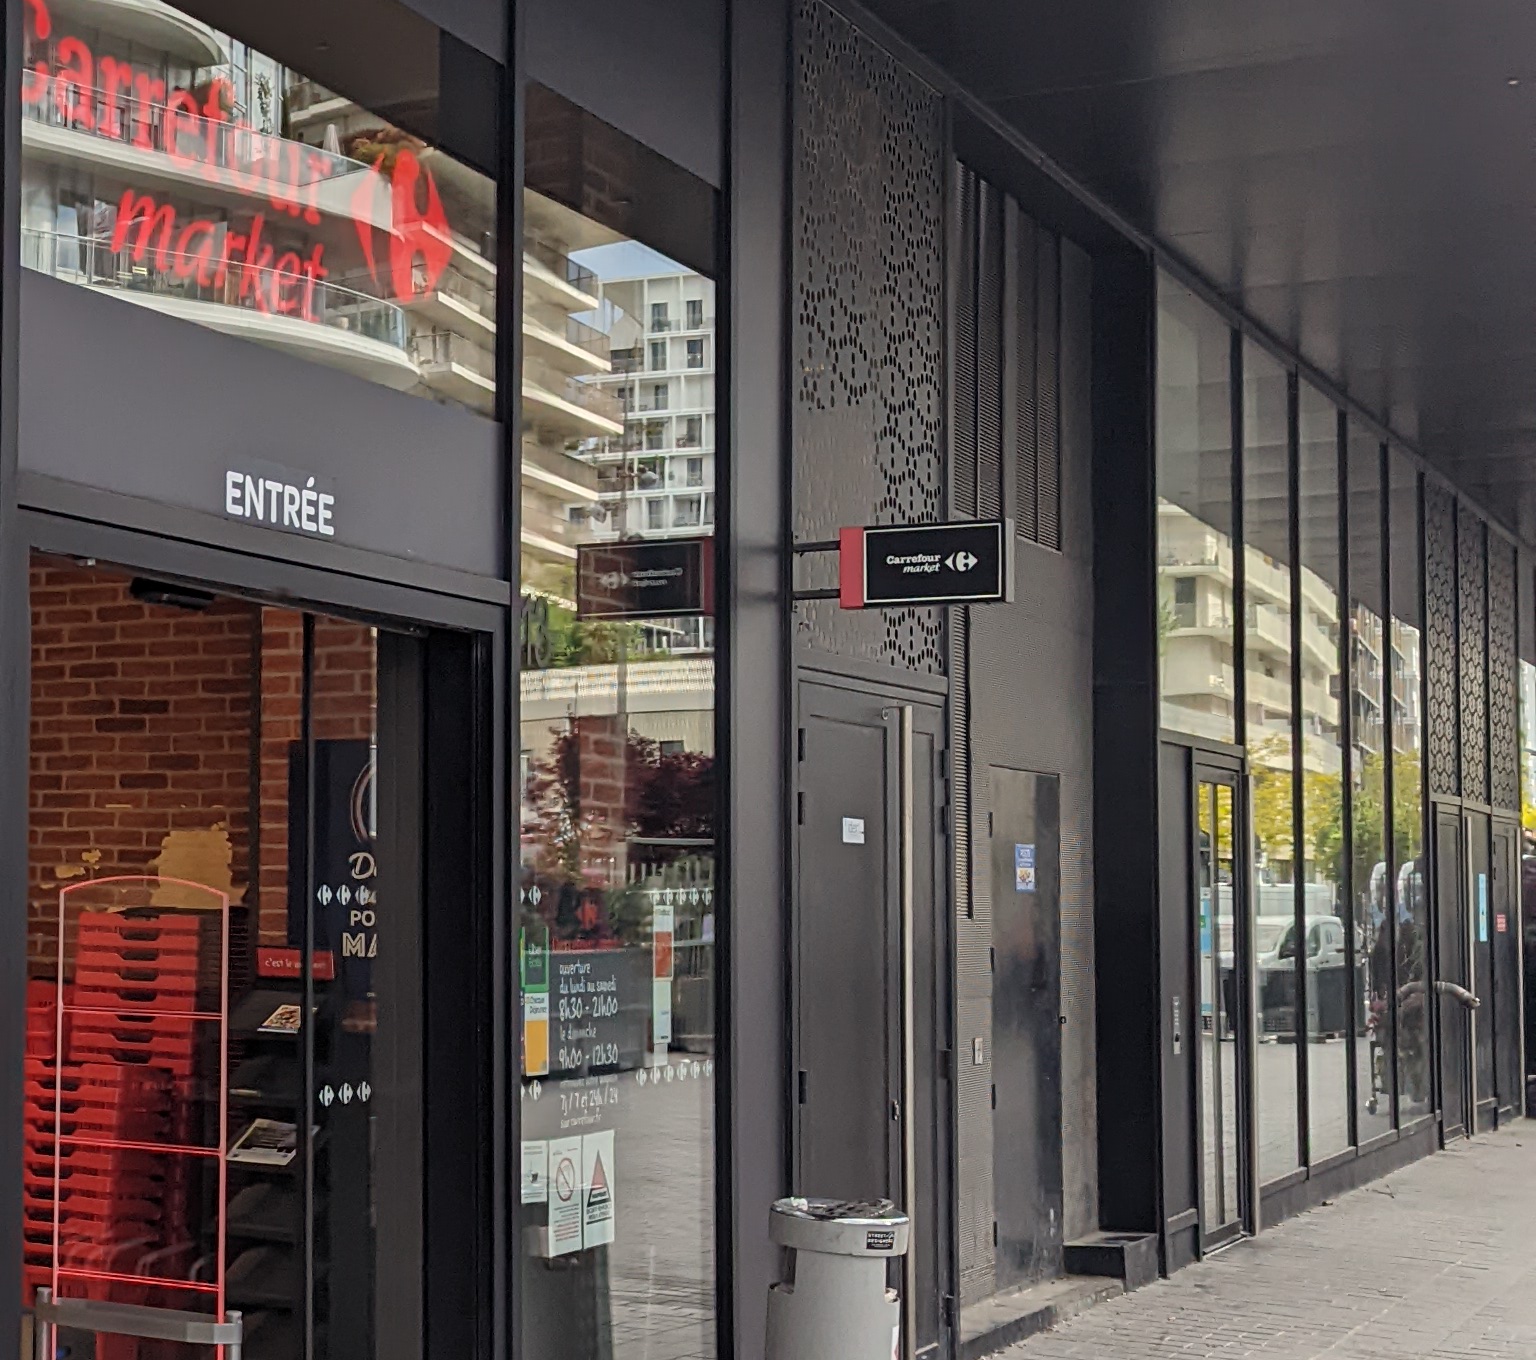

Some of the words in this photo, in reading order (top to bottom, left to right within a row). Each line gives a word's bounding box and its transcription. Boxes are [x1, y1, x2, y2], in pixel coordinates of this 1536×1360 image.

[110, 188, 329, 323] market
[225, 470, 335, 536] ENTRÉE
[885, 553, 942, 565] Carrefour
[902, 562, 941, 574] market
[559, 959, 591, 975] ouverture
[559, 977, 569, 994] du
[570, 976, 586, 993] lundi
[559, 996, 583, 1022] 8h30
[592, 994, 618, 1018] 21h00
[559, 1046, 583, 1070] 9h00
[592, 1042, 619, 1066] 12h30
